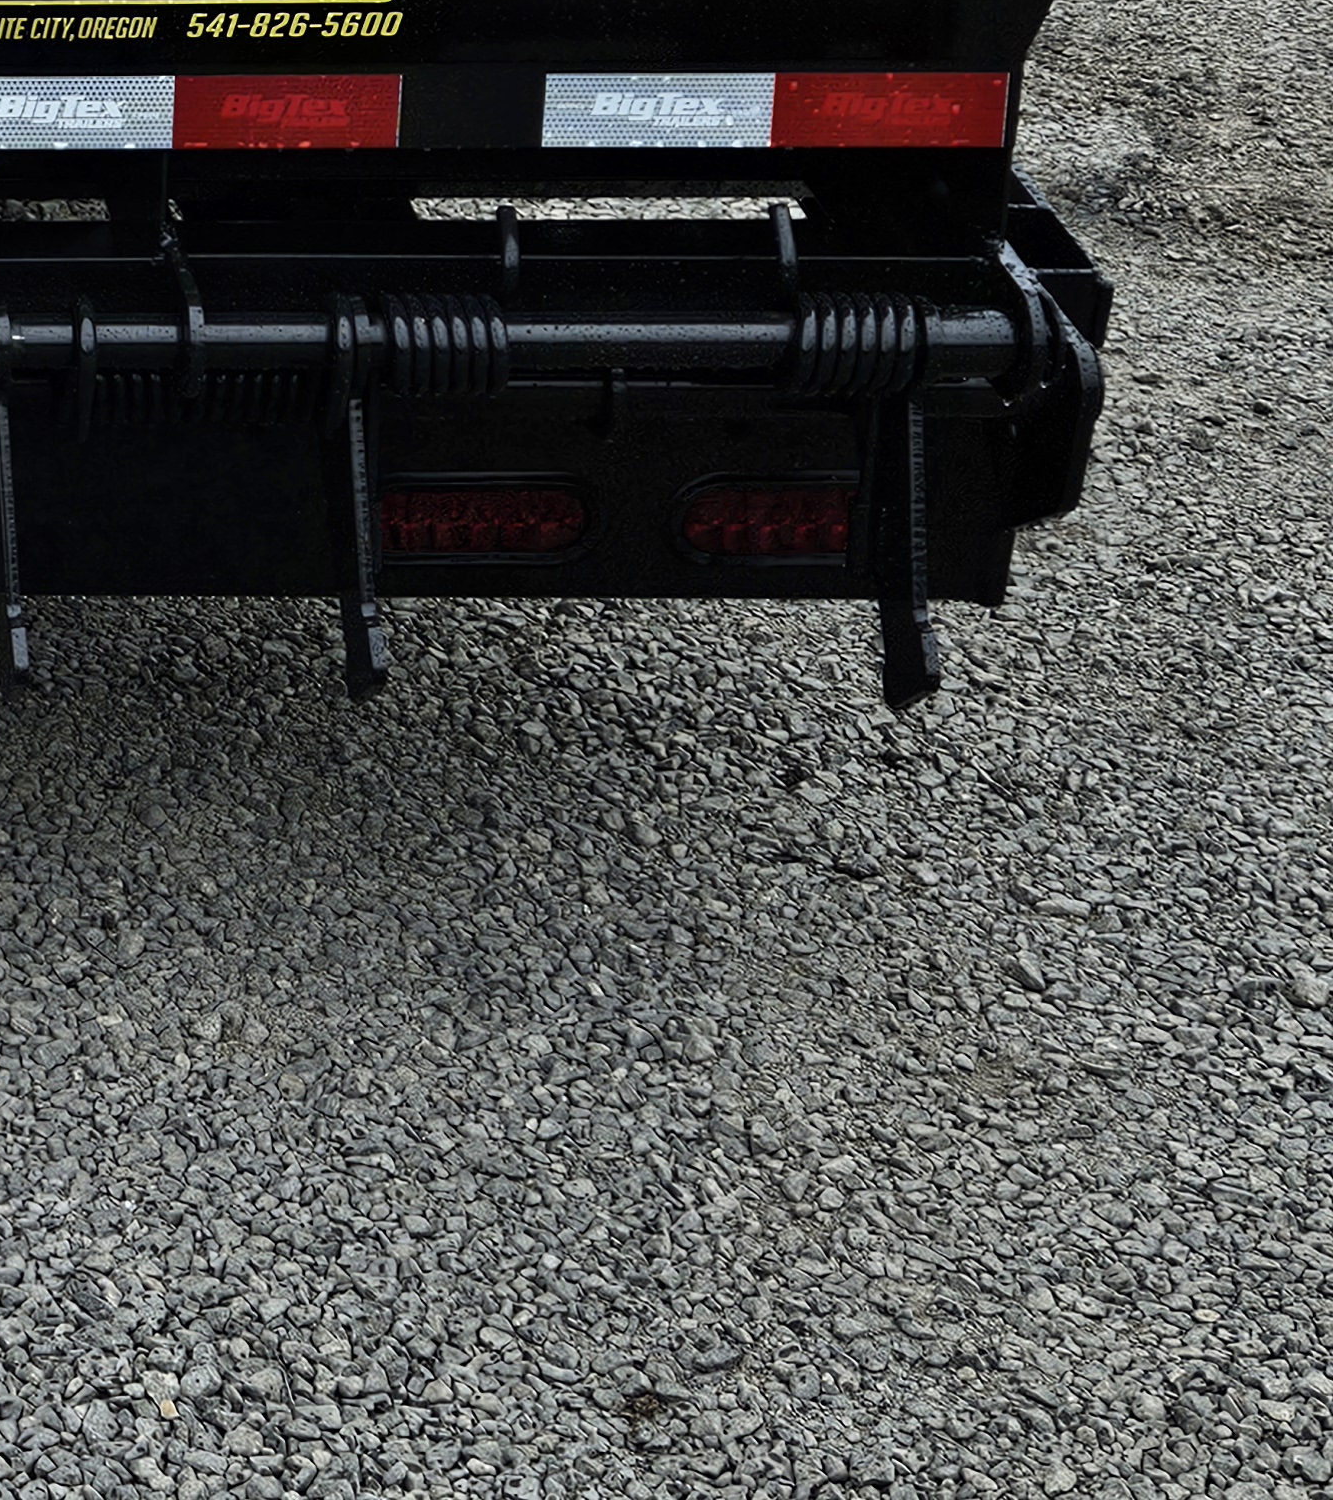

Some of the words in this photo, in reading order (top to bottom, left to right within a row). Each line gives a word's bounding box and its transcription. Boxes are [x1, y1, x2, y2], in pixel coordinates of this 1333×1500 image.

[187, 11, 404, 38] 541-826-5600
[222, 94, 347, 124] BigTex
[591, 92, 723, 121] BigTex
